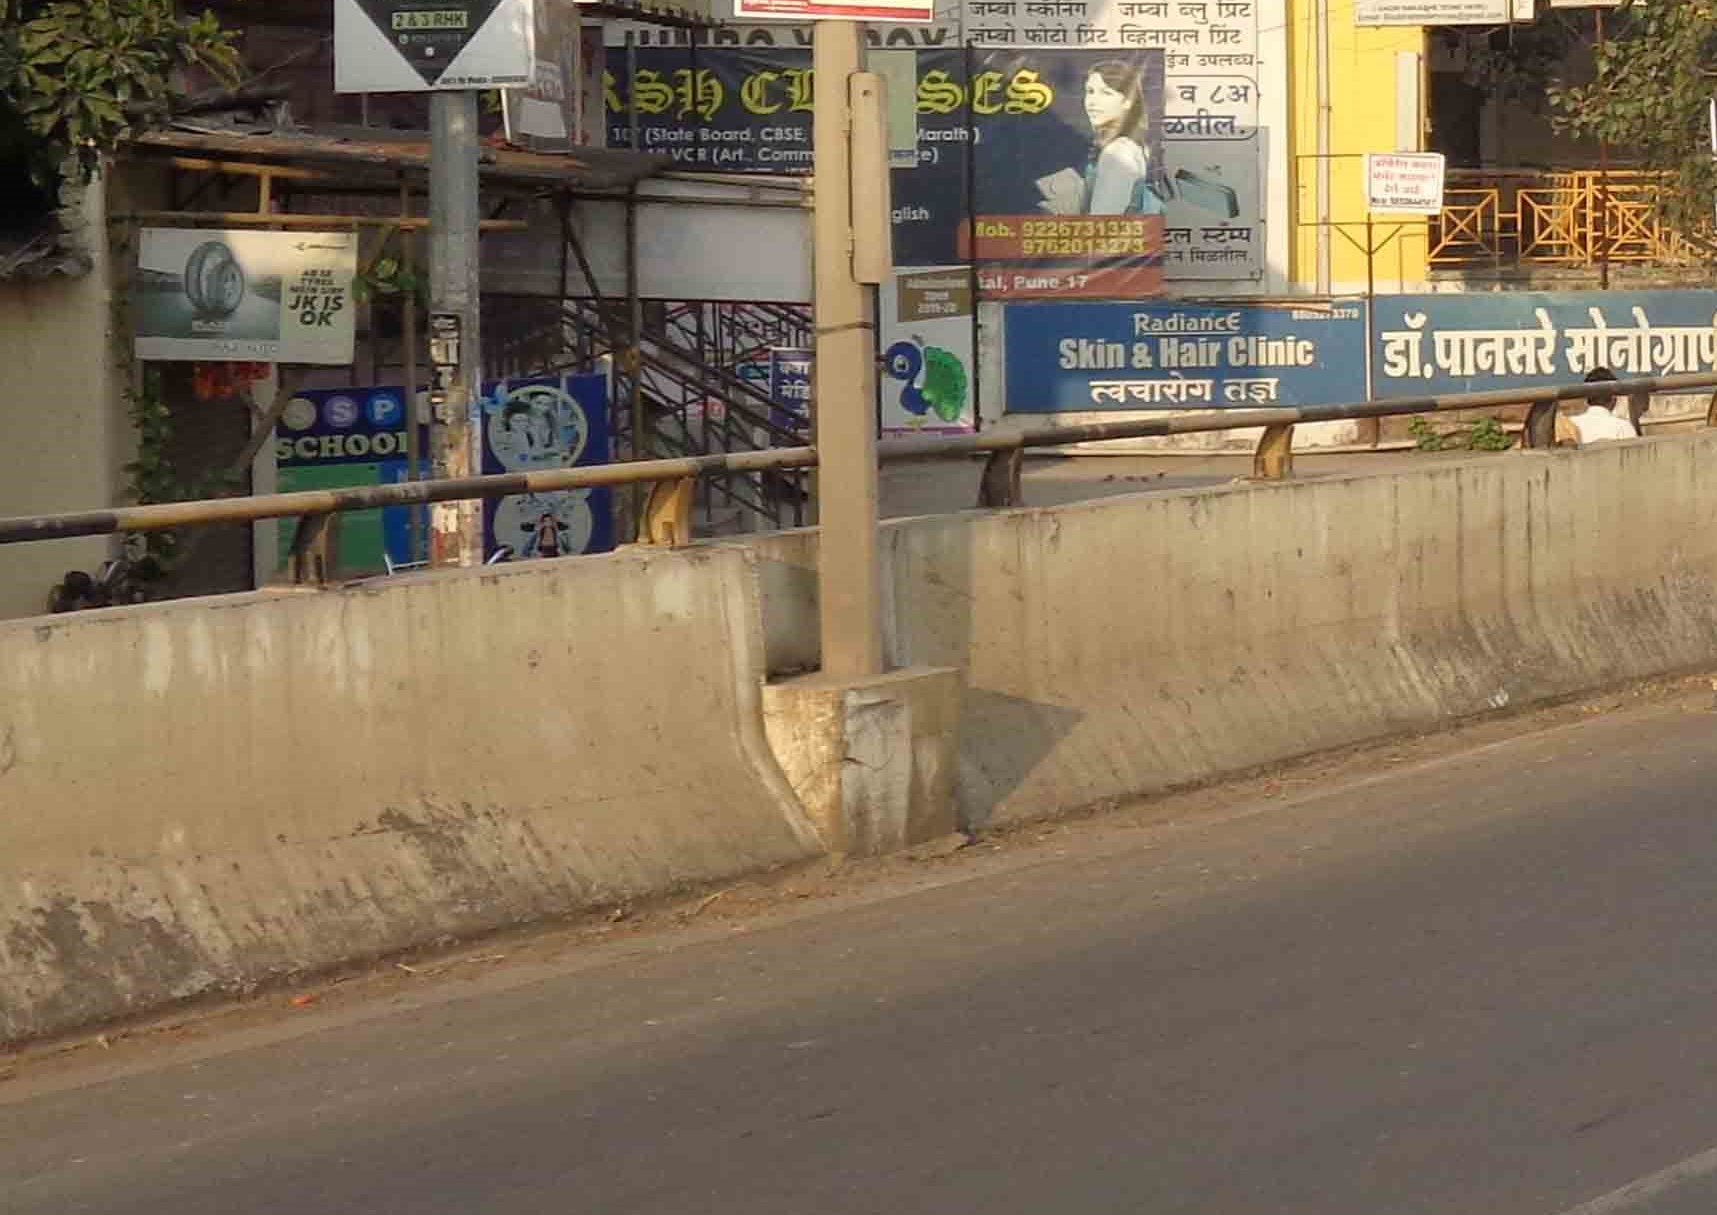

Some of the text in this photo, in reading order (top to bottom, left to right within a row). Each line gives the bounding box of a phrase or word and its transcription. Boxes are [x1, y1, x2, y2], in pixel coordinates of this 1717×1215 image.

[740, 66, 1056, 117] CLSES
[1013, 275, 1065, 291] Pune
[287, 295, 344, 312] JK IS
[300, 311, 333, 327] OK
[1059, 335, 1315, 370] Skin & Hair Clinic
[1088, 371, 1215, 404] त्वचारोग
